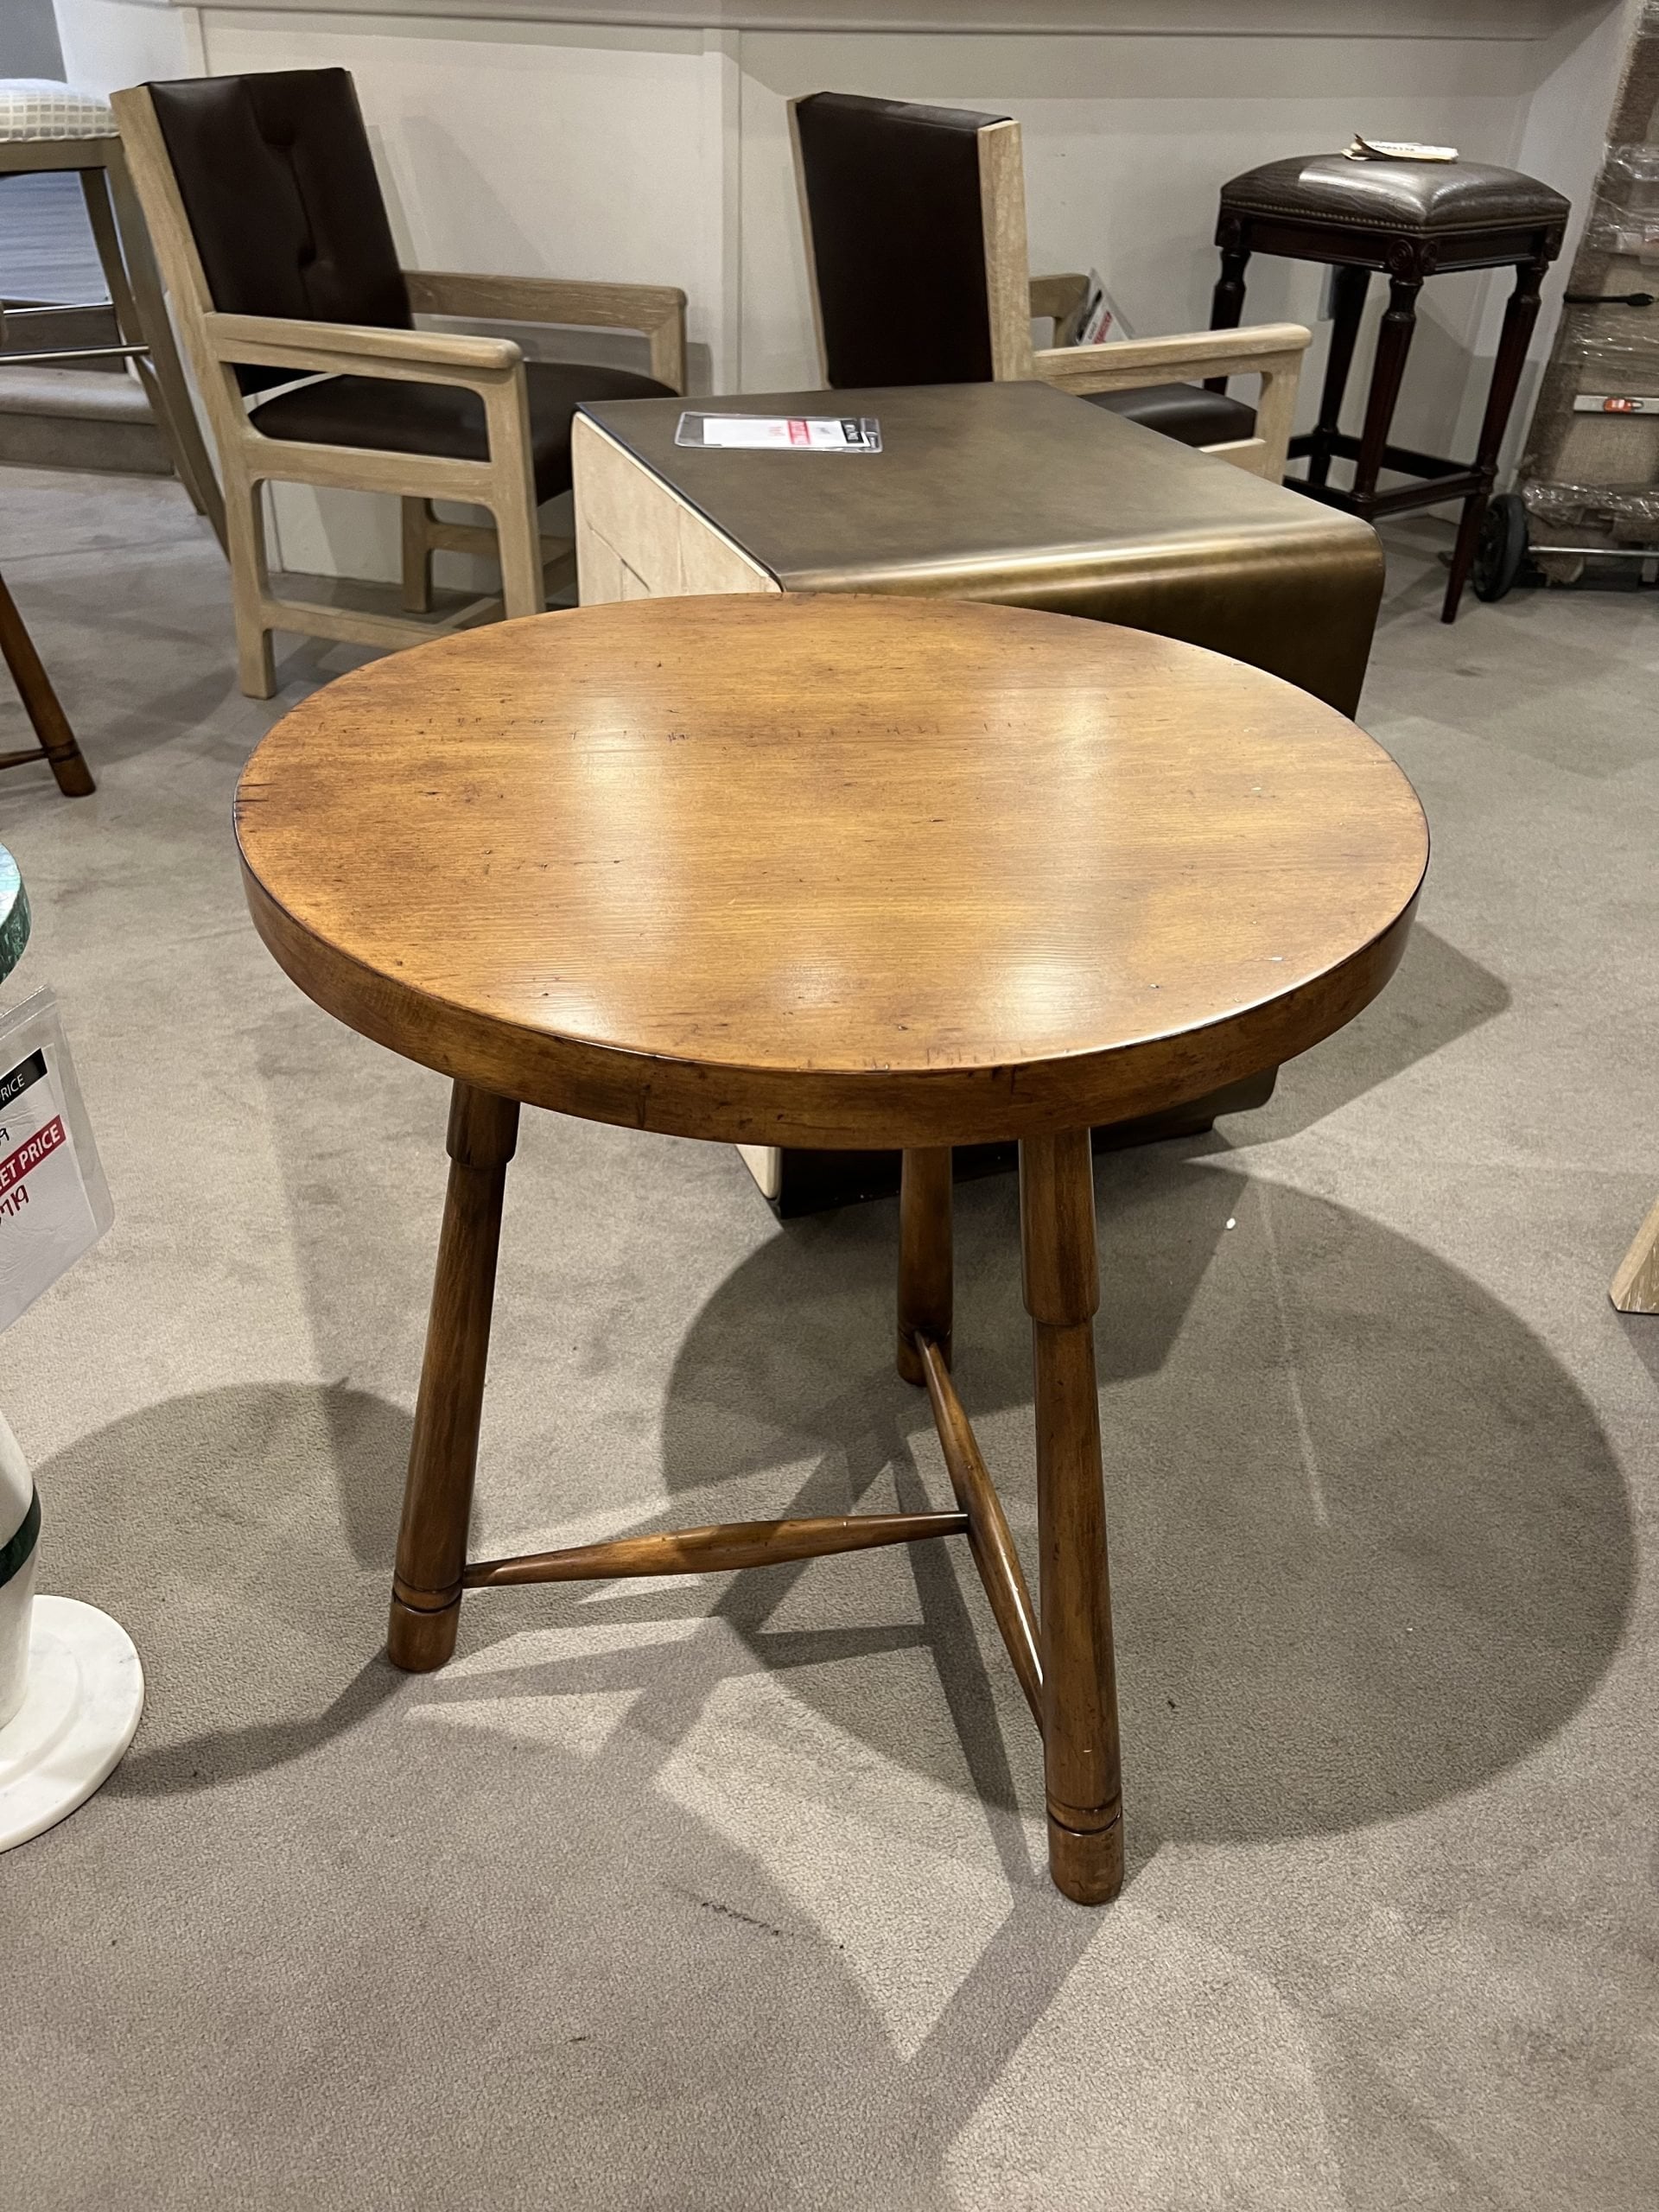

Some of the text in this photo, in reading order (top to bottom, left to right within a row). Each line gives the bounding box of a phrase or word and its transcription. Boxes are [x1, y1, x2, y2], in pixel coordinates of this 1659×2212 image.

[0, 1073, 25, 1101] RICE
[0, 1123, 60, 1190] ET PRICE
[0, 1185, 29, 1224] 719
